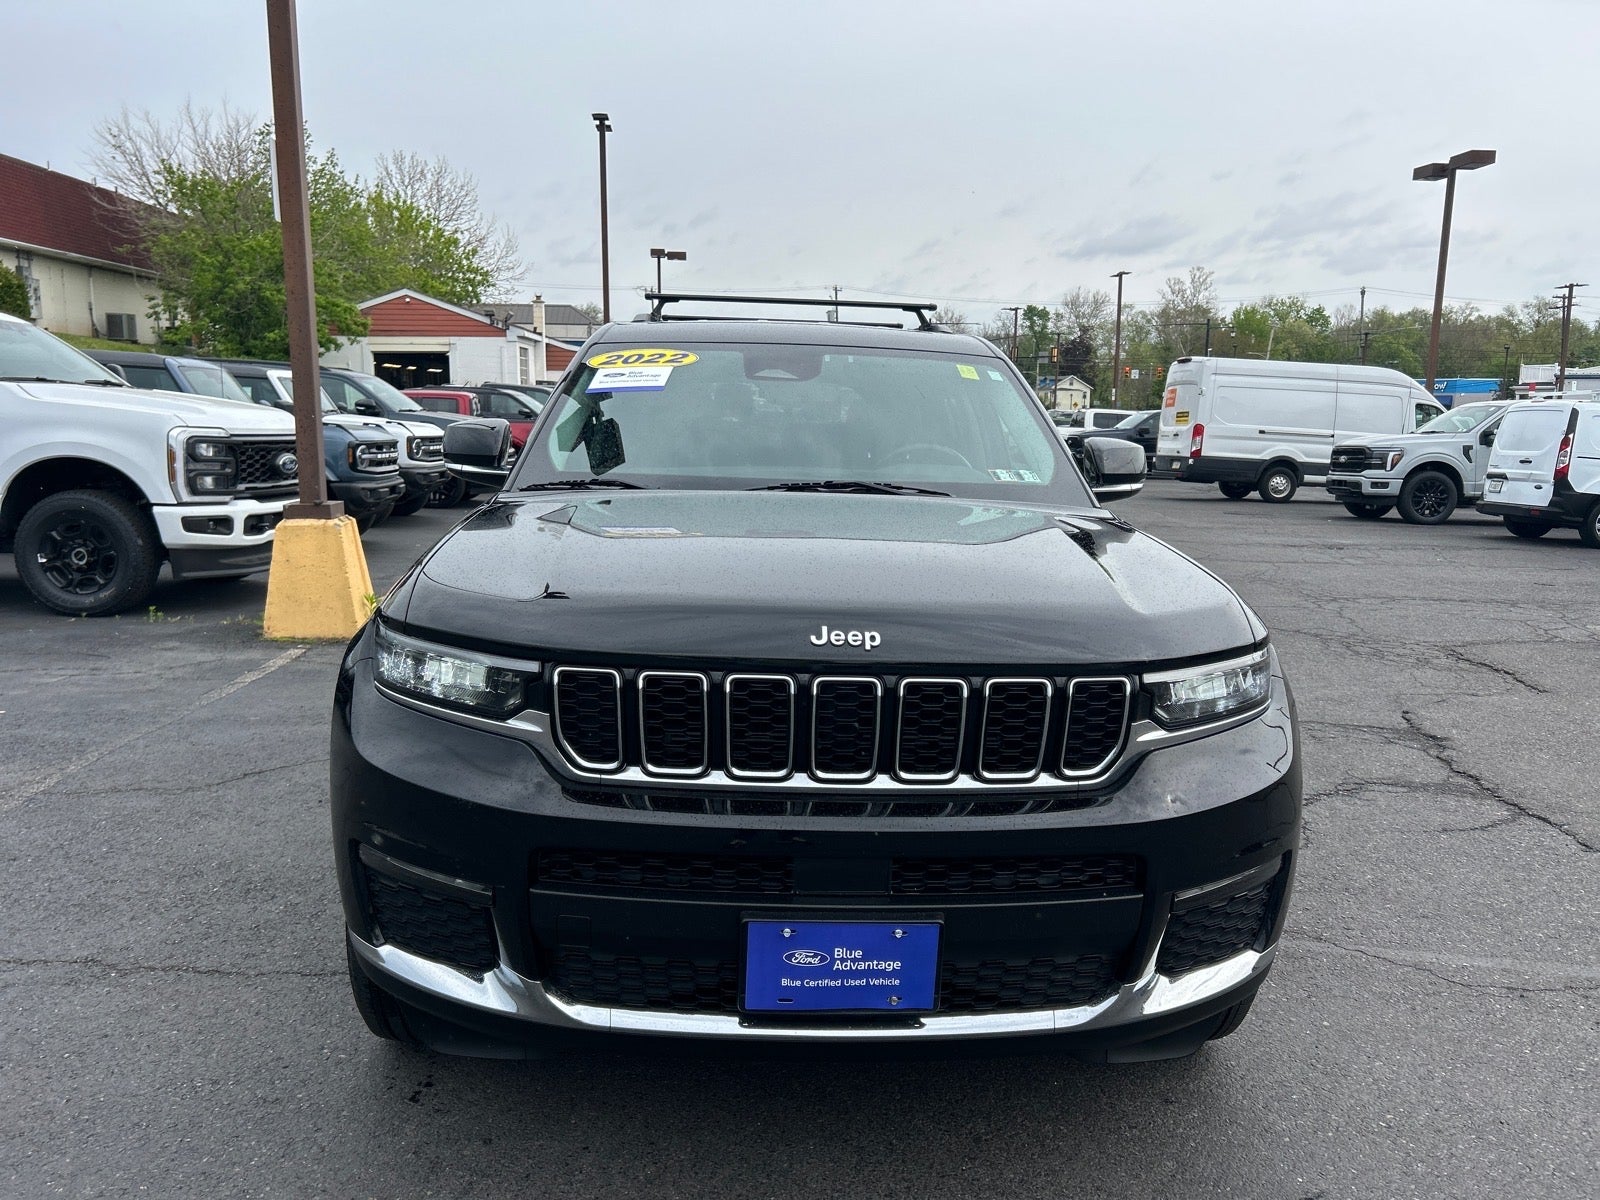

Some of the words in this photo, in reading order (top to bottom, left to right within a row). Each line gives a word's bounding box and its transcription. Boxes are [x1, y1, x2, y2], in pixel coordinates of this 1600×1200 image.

[598, 353, 689, 366] 2022
[810, 625, 881, 650] Jeep
[789, 951, 822, 965] Ford
[834, 947, 863, 959] Blue
[833, 959, 901, 972] Advantage
[781, 978, 801, 986] Blue
[804, 978, 841, 987] Certified
[844, 978, 866, 986] Used
[868, 977, 900, 986] Vehicle
